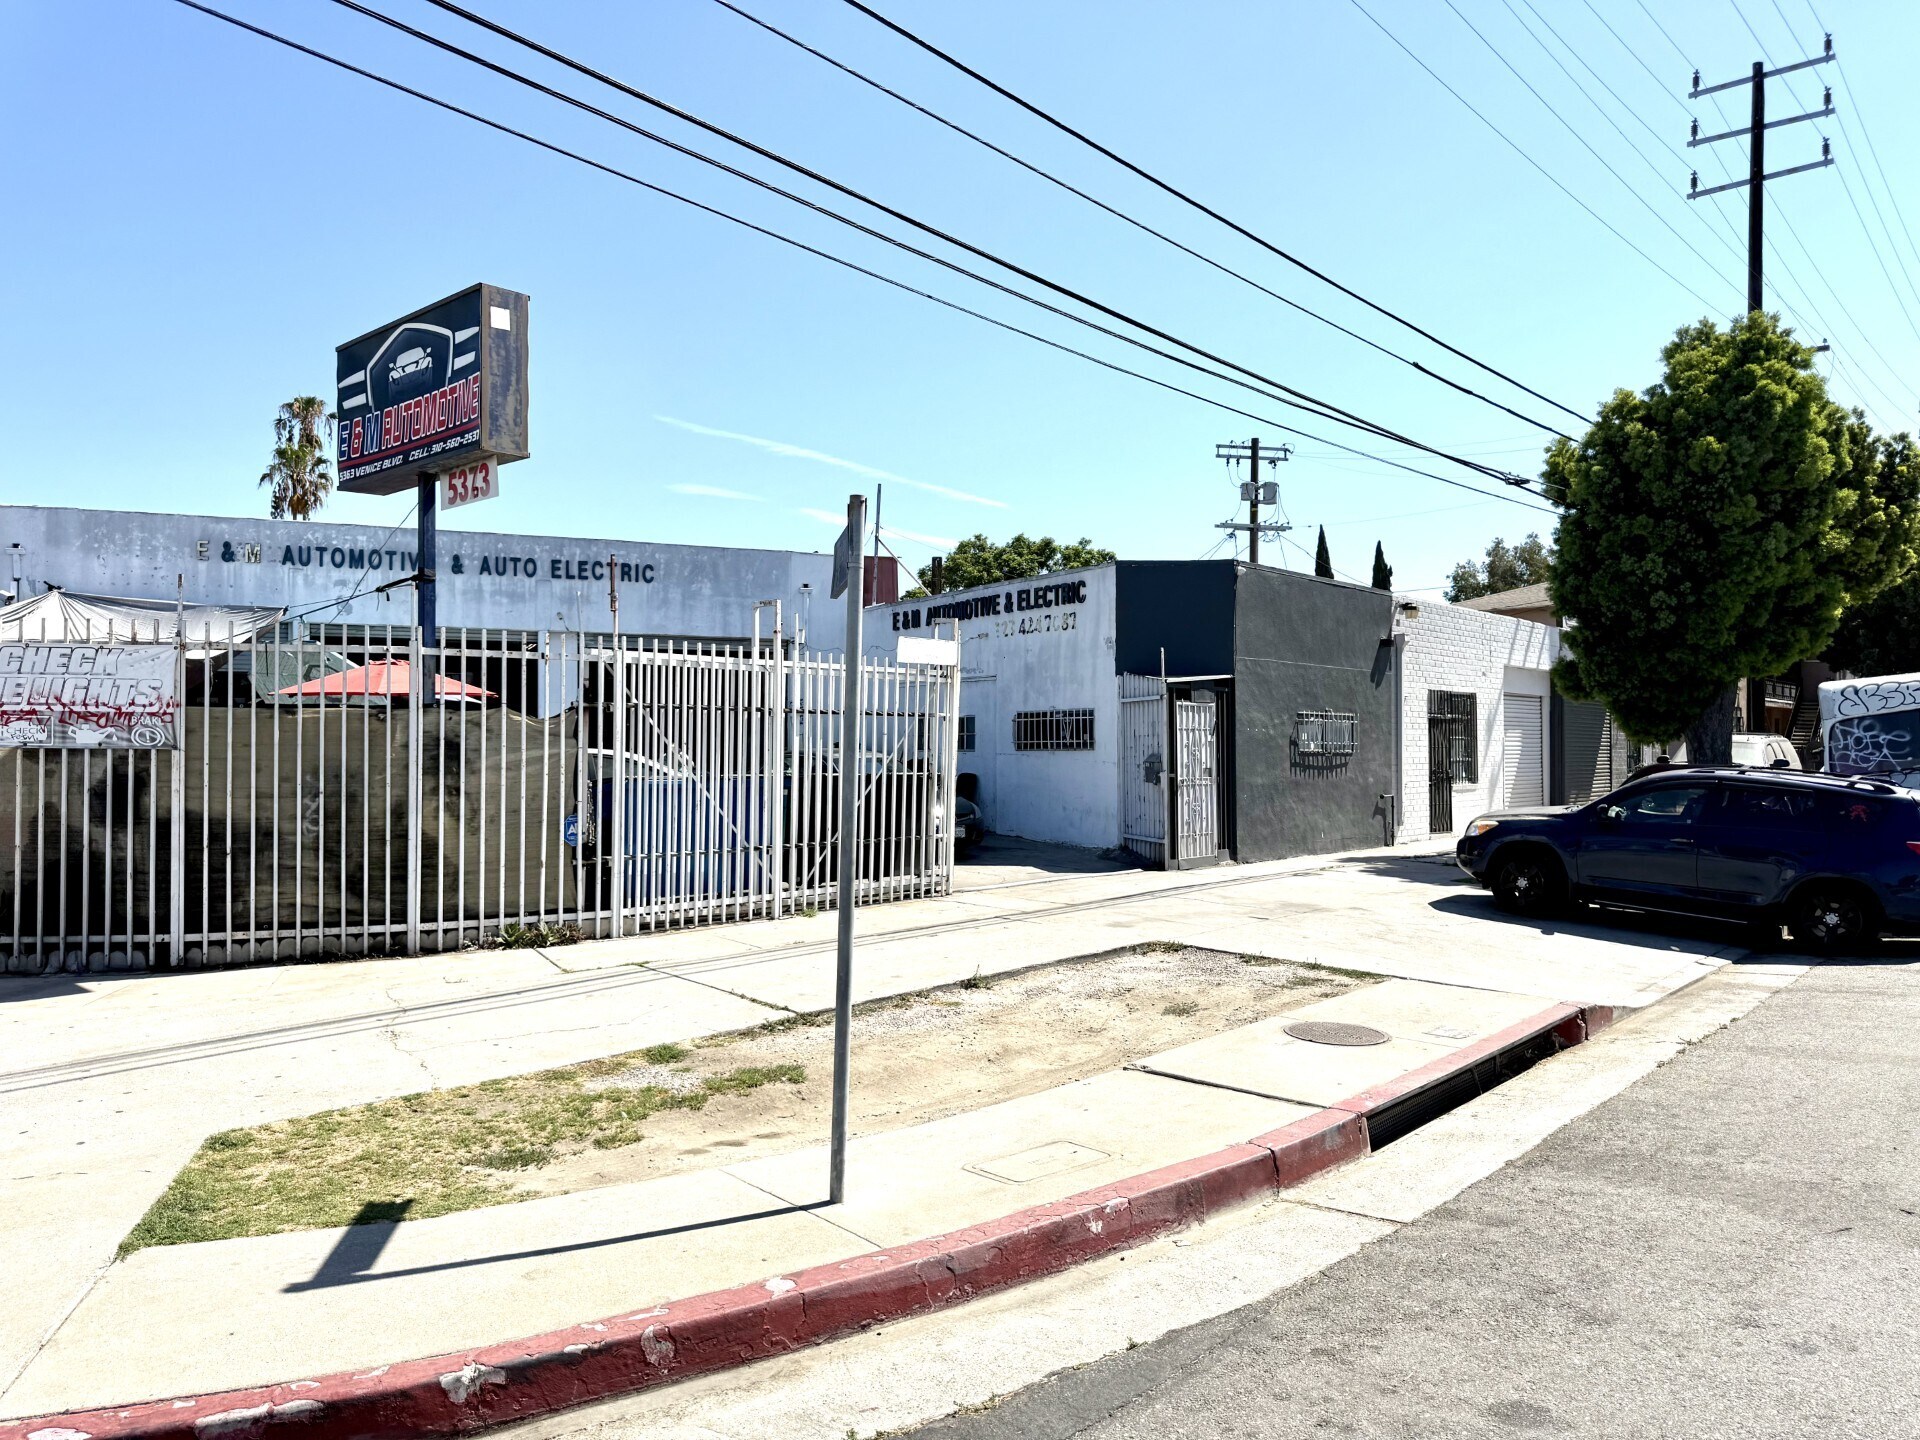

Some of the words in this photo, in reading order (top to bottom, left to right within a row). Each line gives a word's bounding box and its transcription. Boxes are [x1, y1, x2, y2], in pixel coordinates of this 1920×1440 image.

[338, 421, 350, 461] E
[351, 417, 363, 458] &
[364, 411, 381, 455] M
[381, 372, 480, 450] AUTOMOTIVE
[355, 461, 382, 477] VENICE
[196, 540, 209, 561] E
[221, 541, 235, 563] &
[244, 543, 261, 564] M
[281, 545, 419, 571] AUTOMOTIV
[451, 554, 464, 575] &
[479, 555, 537, 578] AUTO
[551, 559, 655, 583] ELECTRIC
[892, 612, 900, 631] E
[902, 610, 910, 630] &
[911, 609, 921, 628] M
[925, 594, 1000, 627] AUTOMOTIVE
[1004, 592, 1013, 613] &
[1017, 580, 1087, 611] ELECTRIC
[0, 646, 124, 675] CHECK
